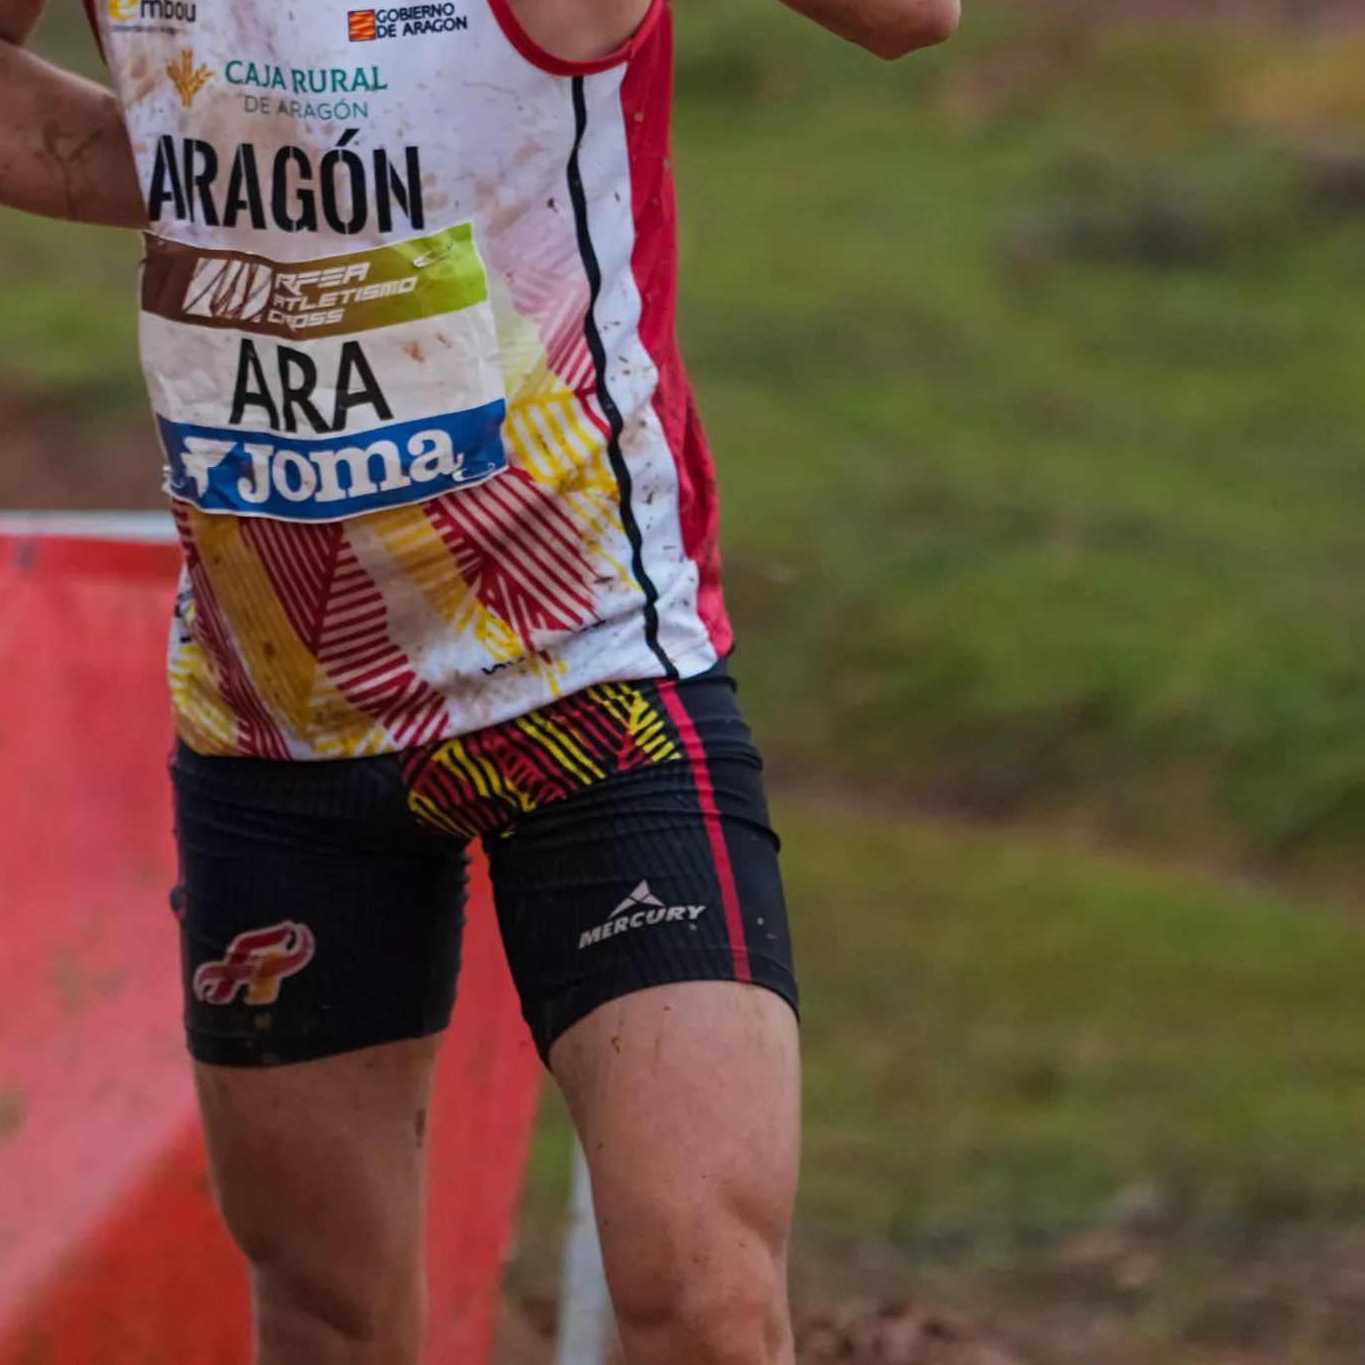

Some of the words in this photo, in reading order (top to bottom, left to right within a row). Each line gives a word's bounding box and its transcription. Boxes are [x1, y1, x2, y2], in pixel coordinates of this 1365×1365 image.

[376, 2, 455, 23] GOBIERNO
[377, 24, 397, 38] DE
[225, 60, 286, 90] CAJA
[291, 66, 388, 94] RURAL
[245, 95, 270, 114] DE
[277, 99, 368, 120] ARAGÓN
[148, 128, 424, 235] ARAGÓN
[273, 276, 418, 311] ATLETISMO
[275, 262, 371, 296] RFEA
[229, 338, 395, 433] ARA
[578, 905, 706, 950] MERCURY
